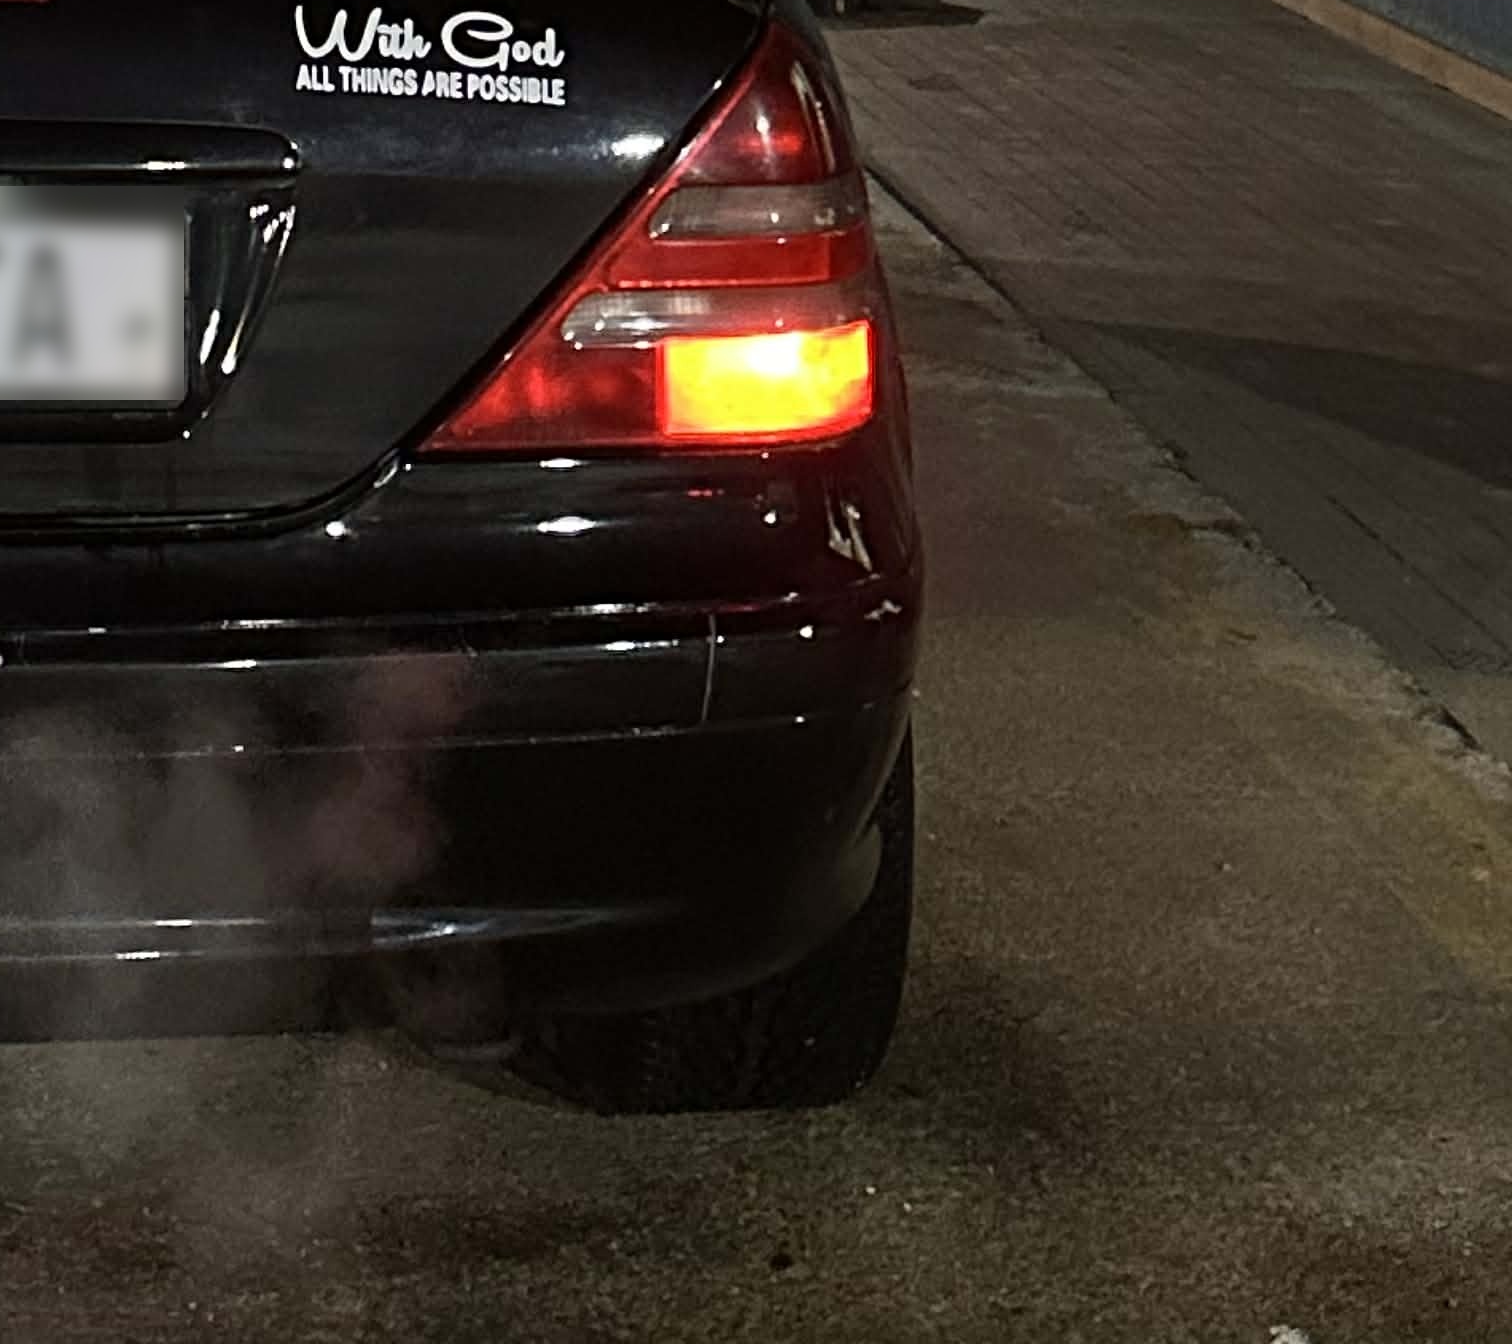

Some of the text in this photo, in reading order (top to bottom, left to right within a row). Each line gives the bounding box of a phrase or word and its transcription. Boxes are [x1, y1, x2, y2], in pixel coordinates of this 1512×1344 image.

[294, 4, 566, 72] With God
[295, 64, 566, 107] ALL THINGS ARE POSSIBLE
